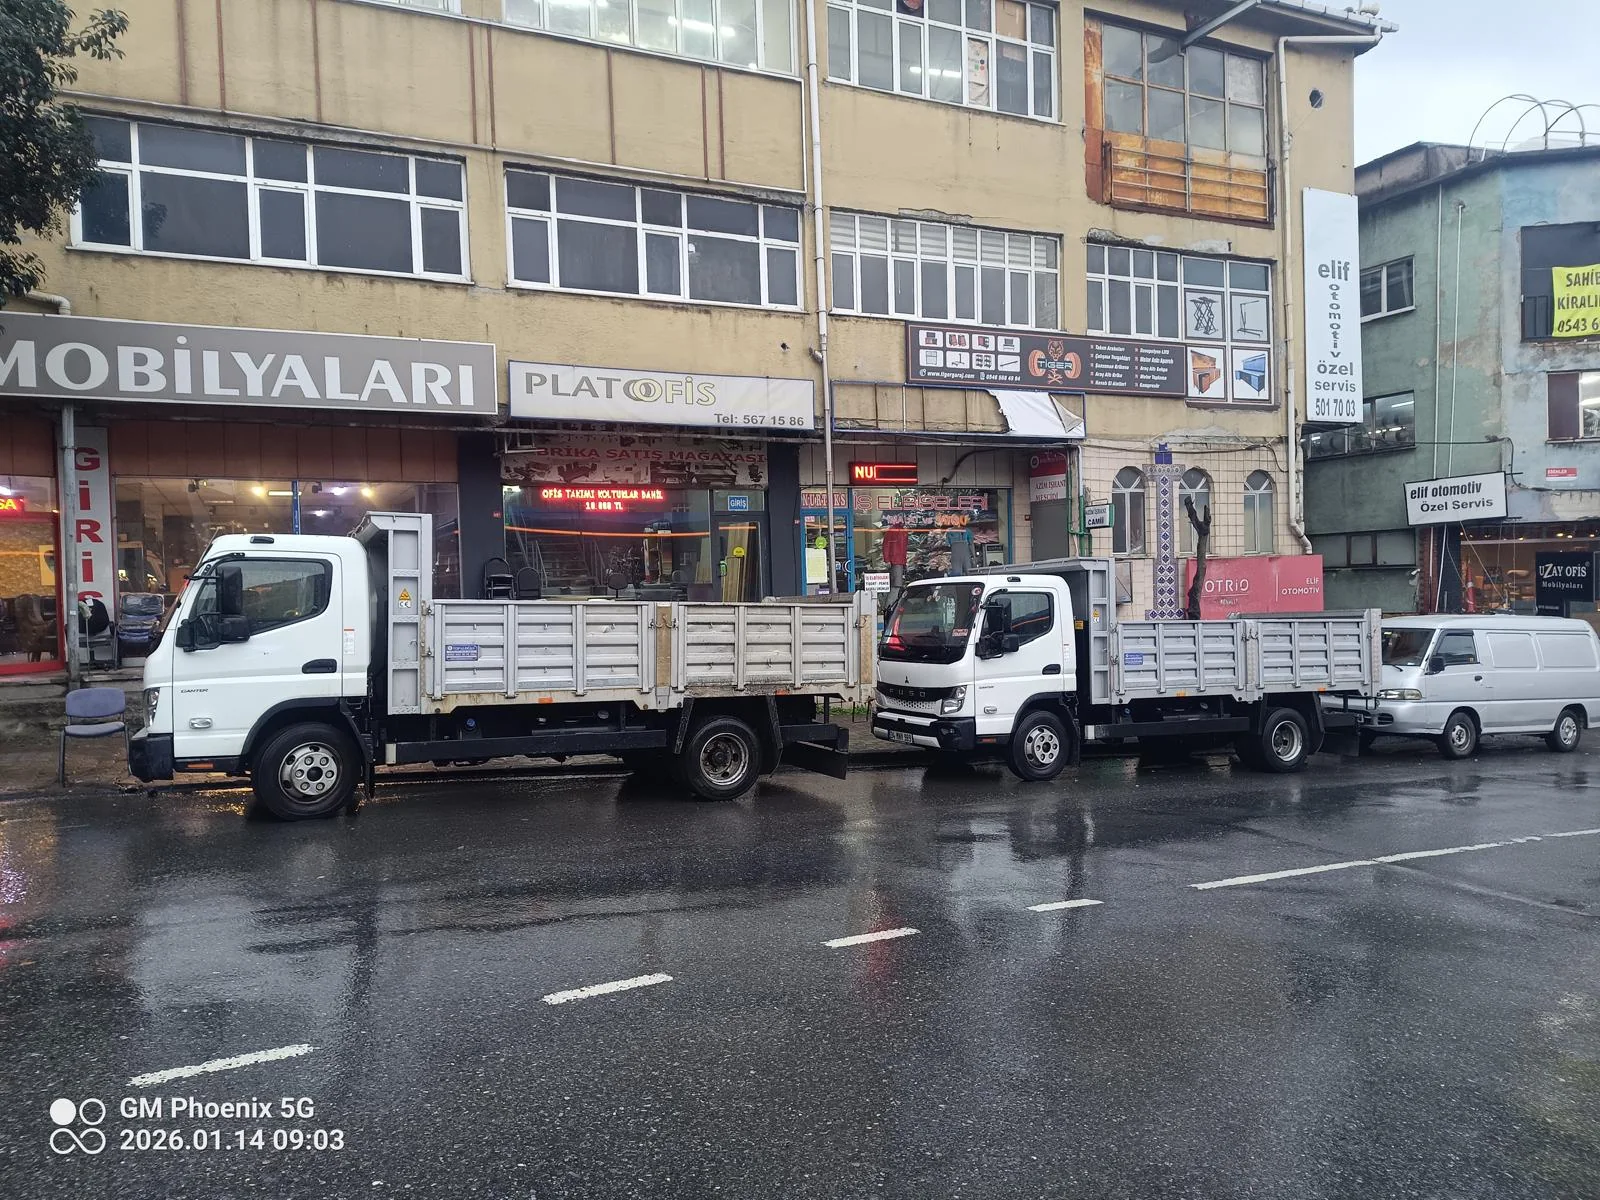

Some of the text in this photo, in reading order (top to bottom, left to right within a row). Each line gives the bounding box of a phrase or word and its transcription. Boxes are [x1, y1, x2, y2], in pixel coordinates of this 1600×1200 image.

[1318, 260, 1350, 281] elif
[1557, 293, 1600, 310] KİRALI
[1328, 283, 1341, 358] otomotiv
[1558, 318, 1587, 333] 0543
[1317, 360, 1353, 376] özel
[1315, 380, 1356, 392] servis
[1316, 398, 1356, 417] 501 70 03
[714, 413, 804, 427] Tel: 567 15 86
[542, 488, 562, 499] OFİS
[1410, 481, 1482, 500] elif otomotiv
[730, 498, 747, 508] GİRİŞ
[802, 493, 846, 506] NURTKS
[1420, 498, 1494, 512] Özel Servis
[1539, 563, 1587, 578] UZAY OFİS
[1306, 577, 1319, 585] ELİF
[1542, 581, 1583, 590] Mobilyaları
[889, 688, 926, 697] FUSO
